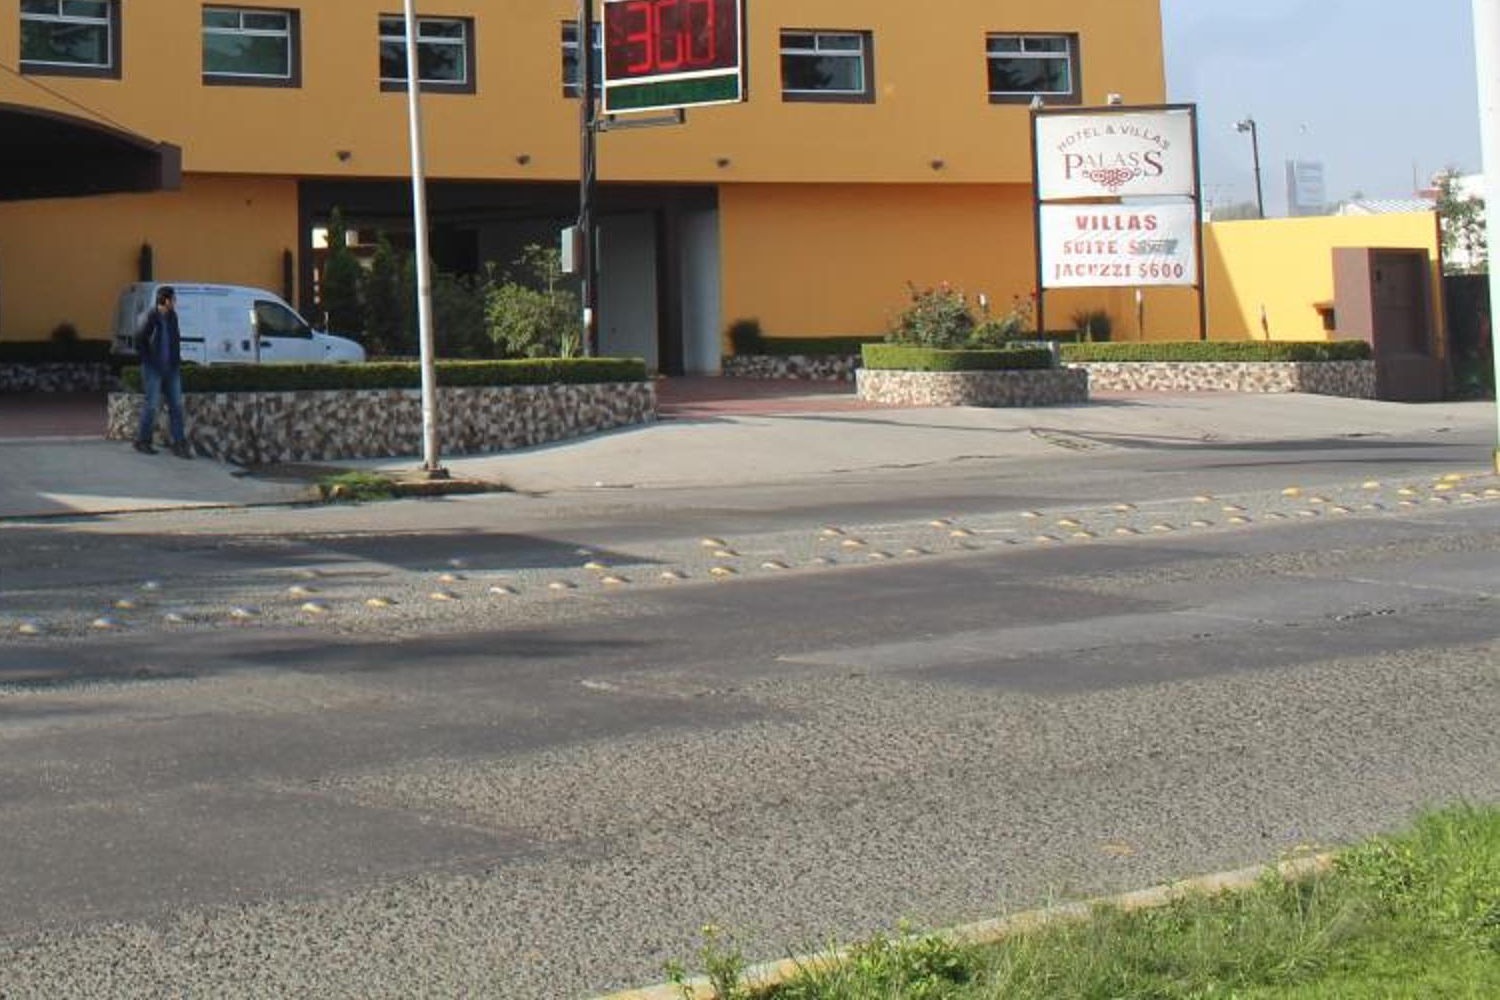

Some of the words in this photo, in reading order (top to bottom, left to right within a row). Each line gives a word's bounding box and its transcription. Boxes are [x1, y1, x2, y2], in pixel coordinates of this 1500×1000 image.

[1057, 128, 1101, 152] HOTEL
[1105, 124, 1115, 134] &
[1119, 125, 1171, 152] VILLAS
[1064, 150, 1164, 180] PALASS
[1076, 215, 1157, 231] VILLAS
[1063, 239, 1118, 255] SUITE
